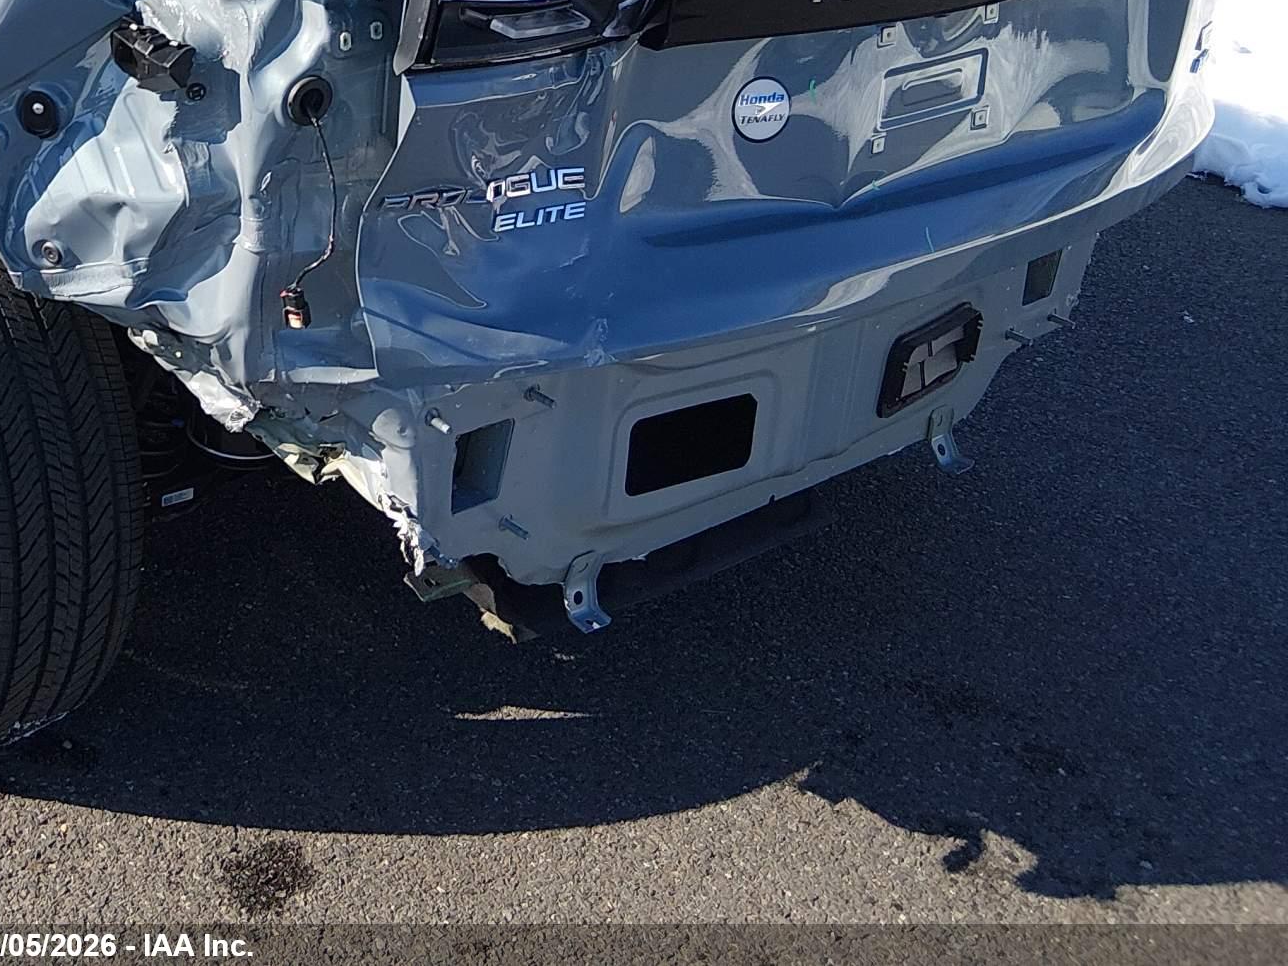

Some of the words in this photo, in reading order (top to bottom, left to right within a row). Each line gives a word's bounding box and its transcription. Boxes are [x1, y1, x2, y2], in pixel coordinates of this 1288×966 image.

[739, 92, 785, 107] Honda
[740, 113, 786, 125] TENAFLY
[378, 167, 585, 210] PROLOGUE
[494, 202, 587, 233] ELITE
